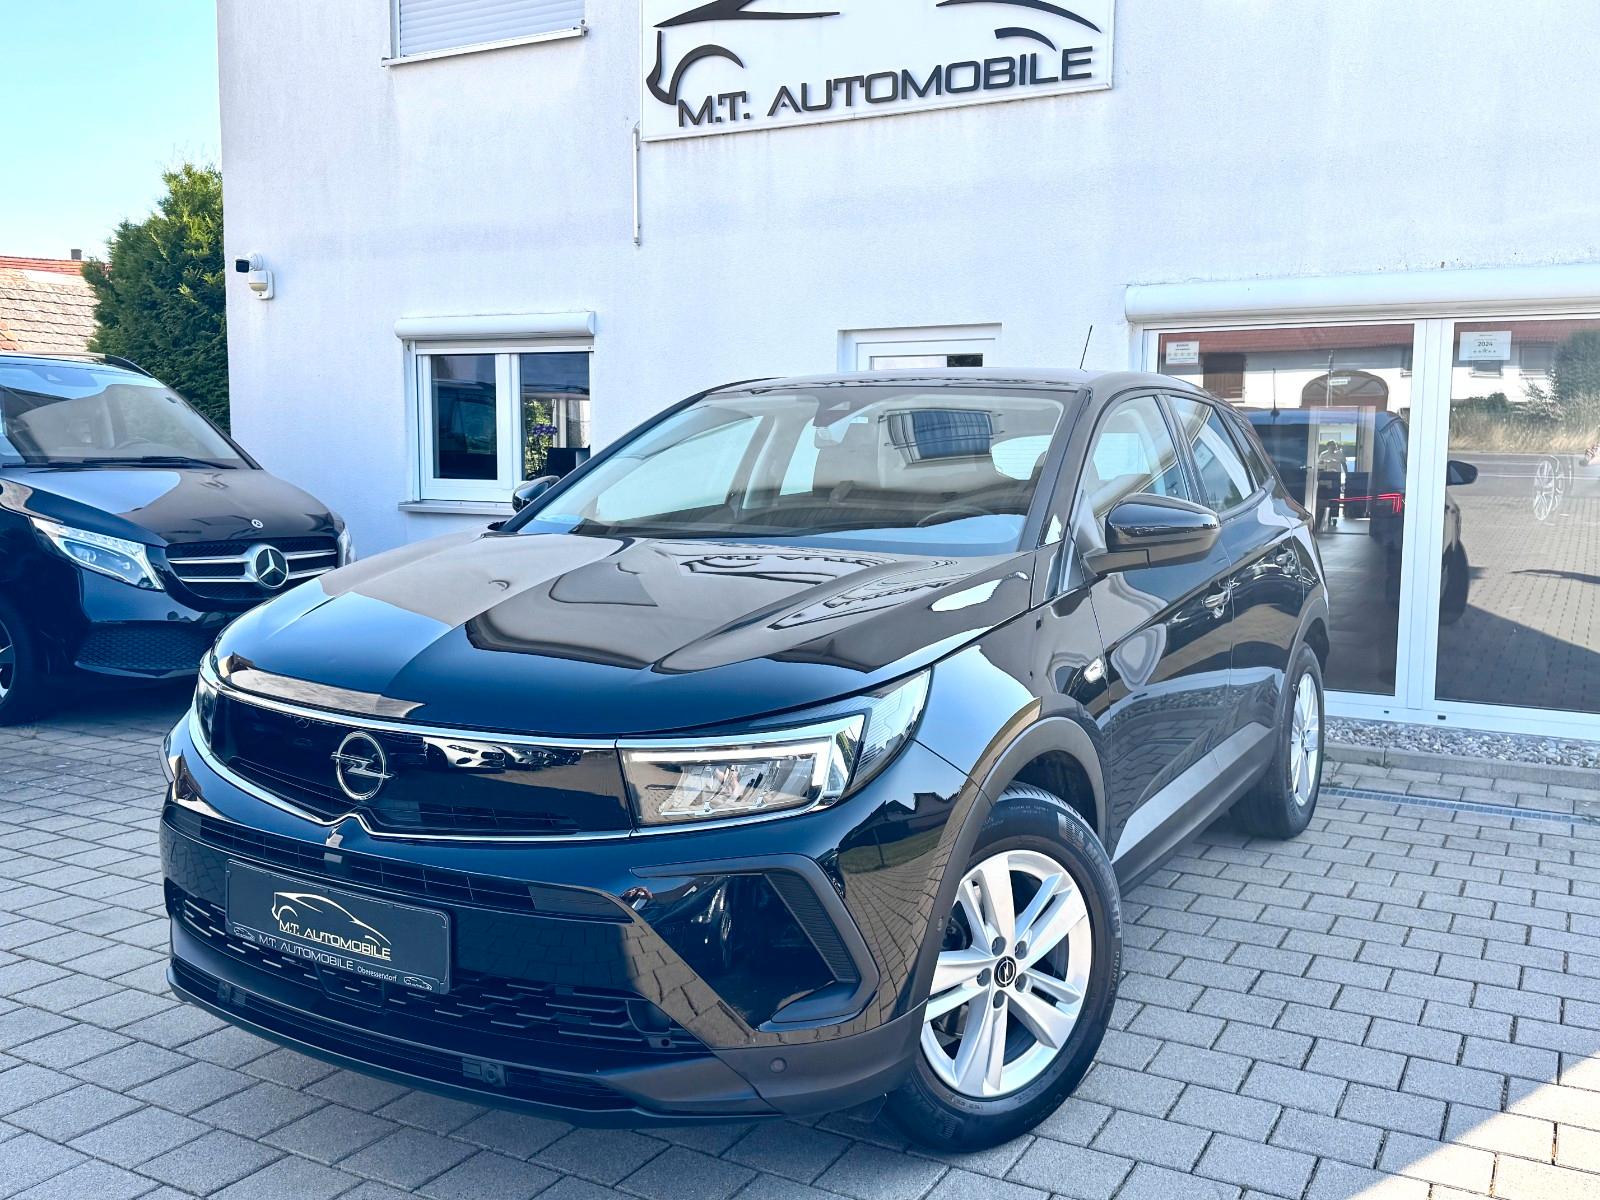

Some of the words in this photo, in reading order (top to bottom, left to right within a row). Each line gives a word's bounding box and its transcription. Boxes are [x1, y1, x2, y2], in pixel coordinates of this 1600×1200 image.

[678, 91, 750, 127] M.T.
[767, 46, 1092, 116] AUTOMOBILE
[259, 935, 277, 949] M.T.
[281, 942, 353, 971] AUTOMOBILE
[280, 920, 299, 935] M.T.
[304, 928, 390, 958] AUTOMOBILE
